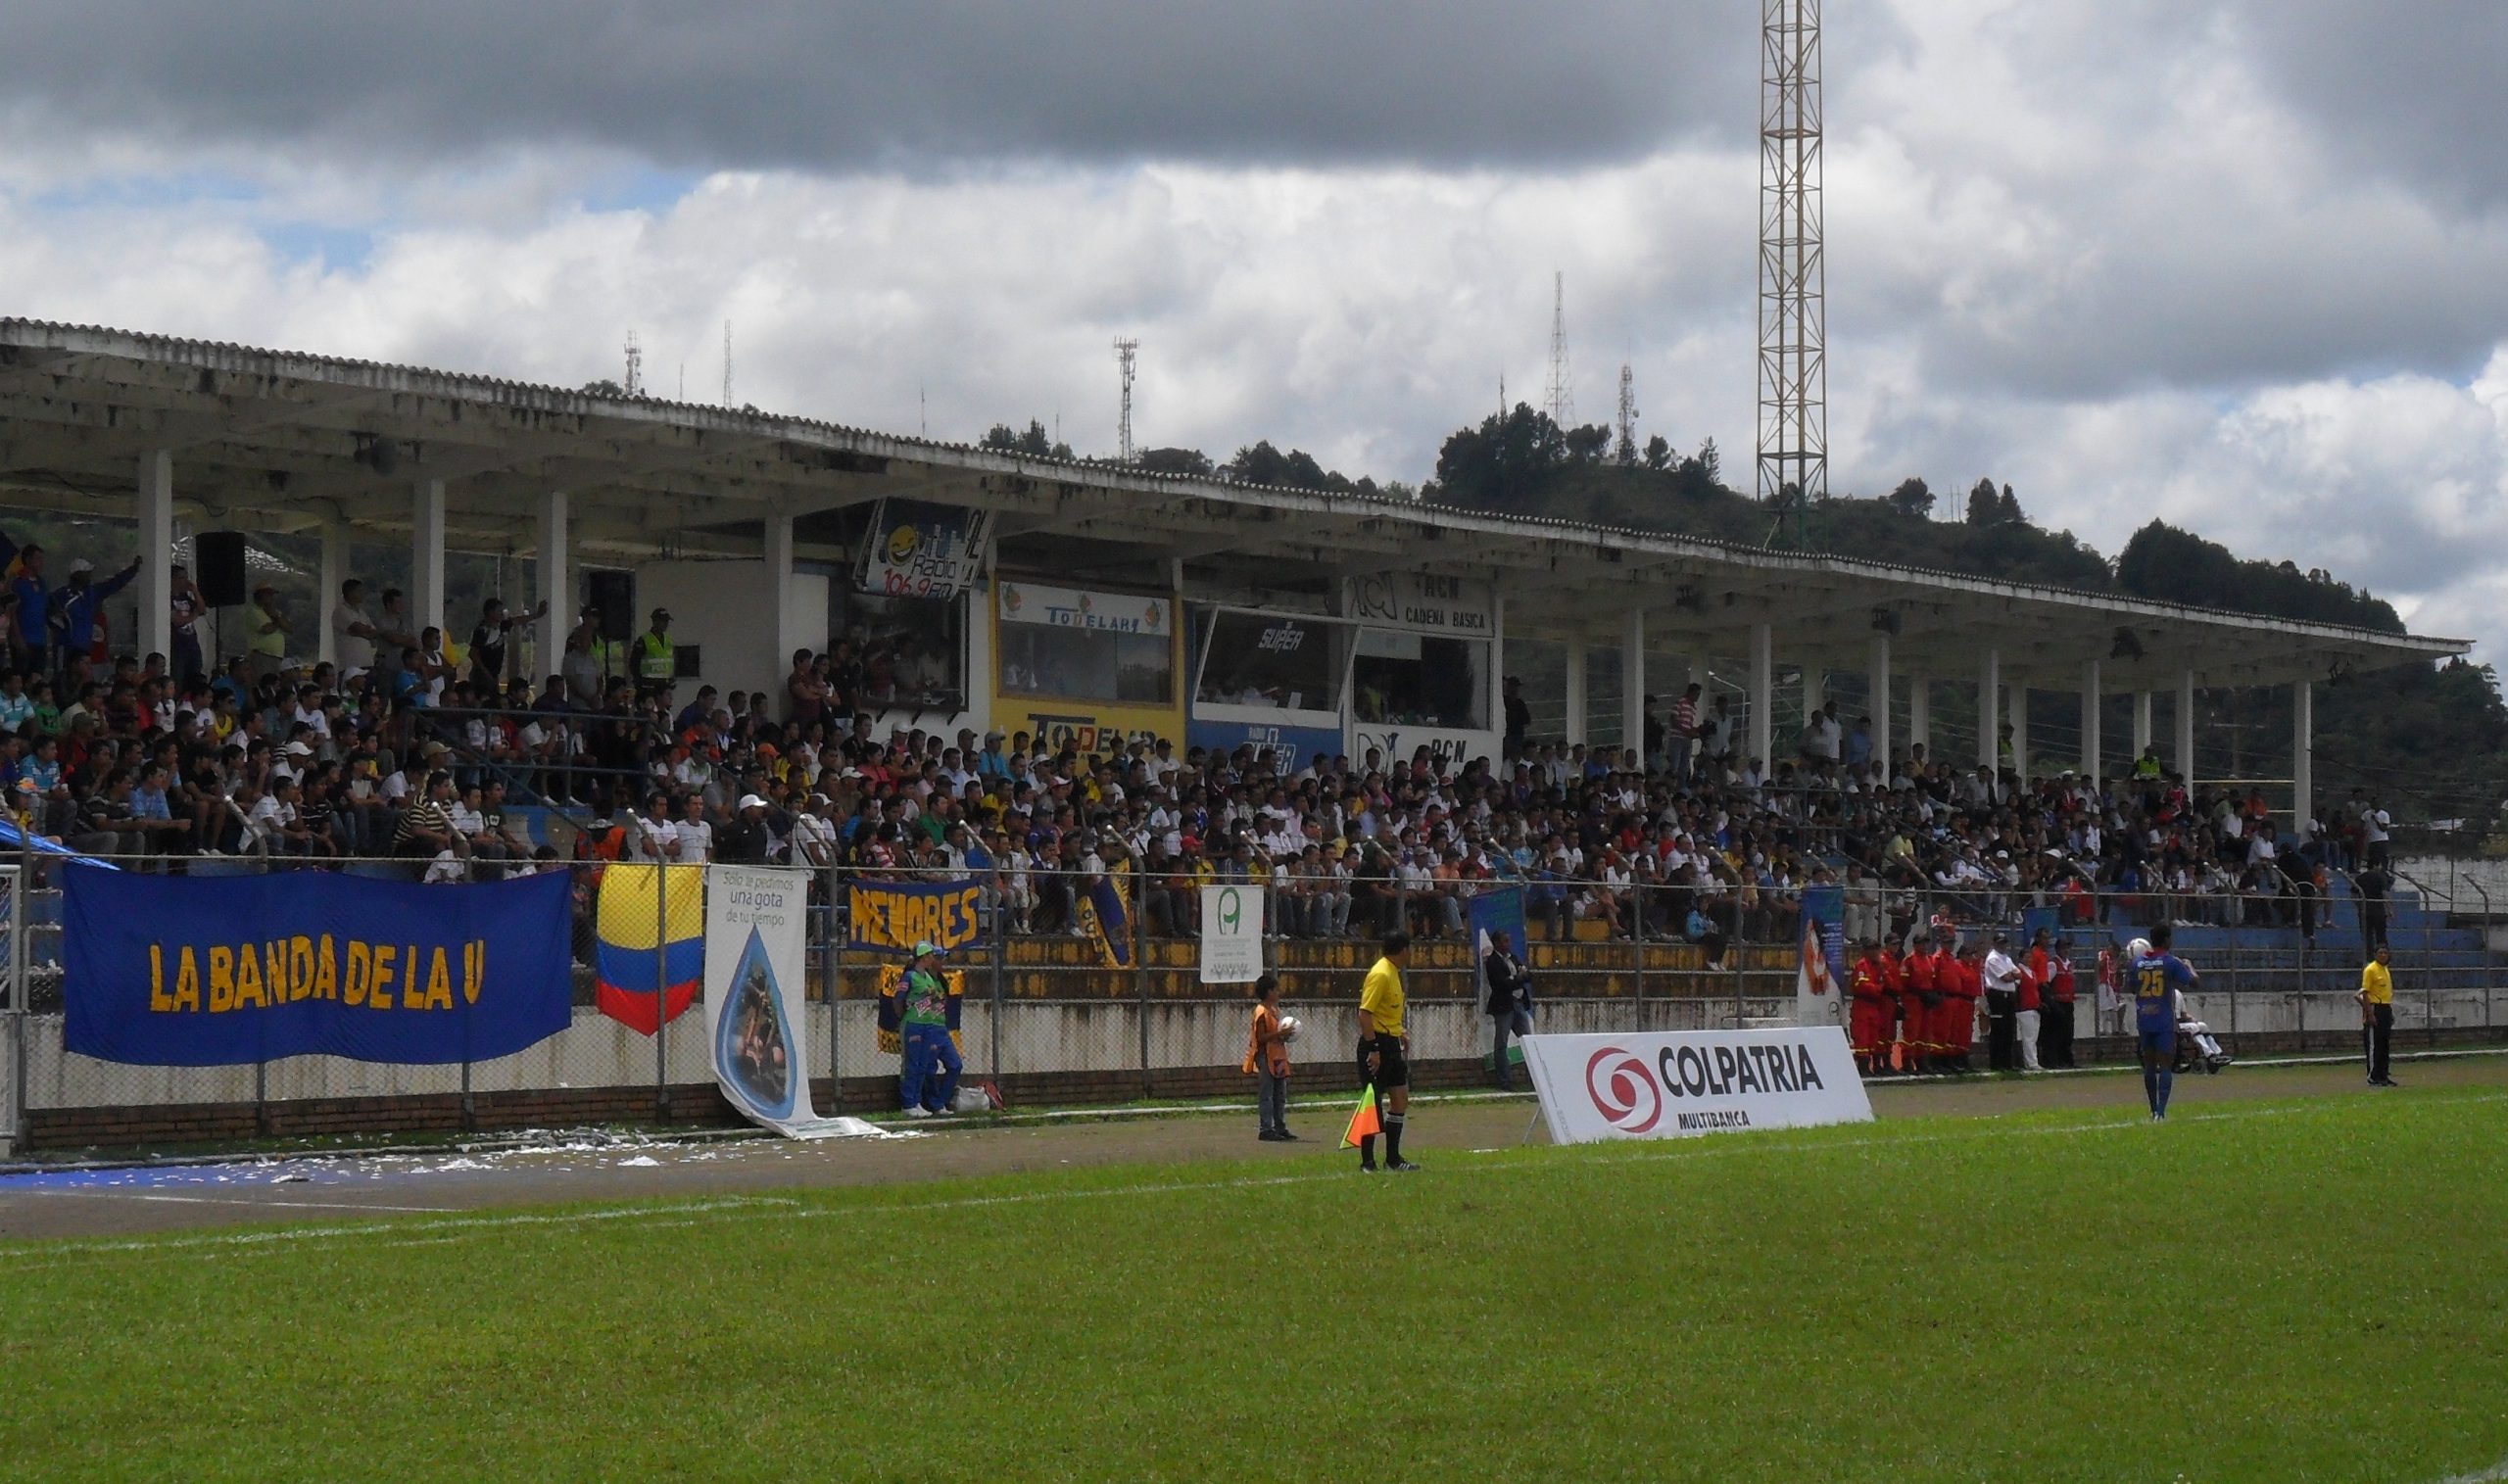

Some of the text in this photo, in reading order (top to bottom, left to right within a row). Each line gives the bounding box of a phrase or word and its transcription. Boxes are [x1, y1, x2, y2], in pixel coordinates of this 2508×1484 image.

[912, 554, 956, 579] Radio
[1424, 575, 1458, 598] RCN
[1045, 606, 1130, 631] TODELAR
[1406, 607, 1485, 629] CADENA BASICA
[1028, 713, 1156, 754] TODER
[1431, 739, 1467, 763] RCN
[731, 890, 783, 910] una gota
[726, 908, 785, 929] de tu tiempo
[150, 933, 485, 1013] LA BANDA DE LA U
[2138, 970, 2164, 997] 25
[1659, 1043, 1824, 1098] COLPATRIA
[1677, 1111, 1751, 1130] MULTIBANCA
